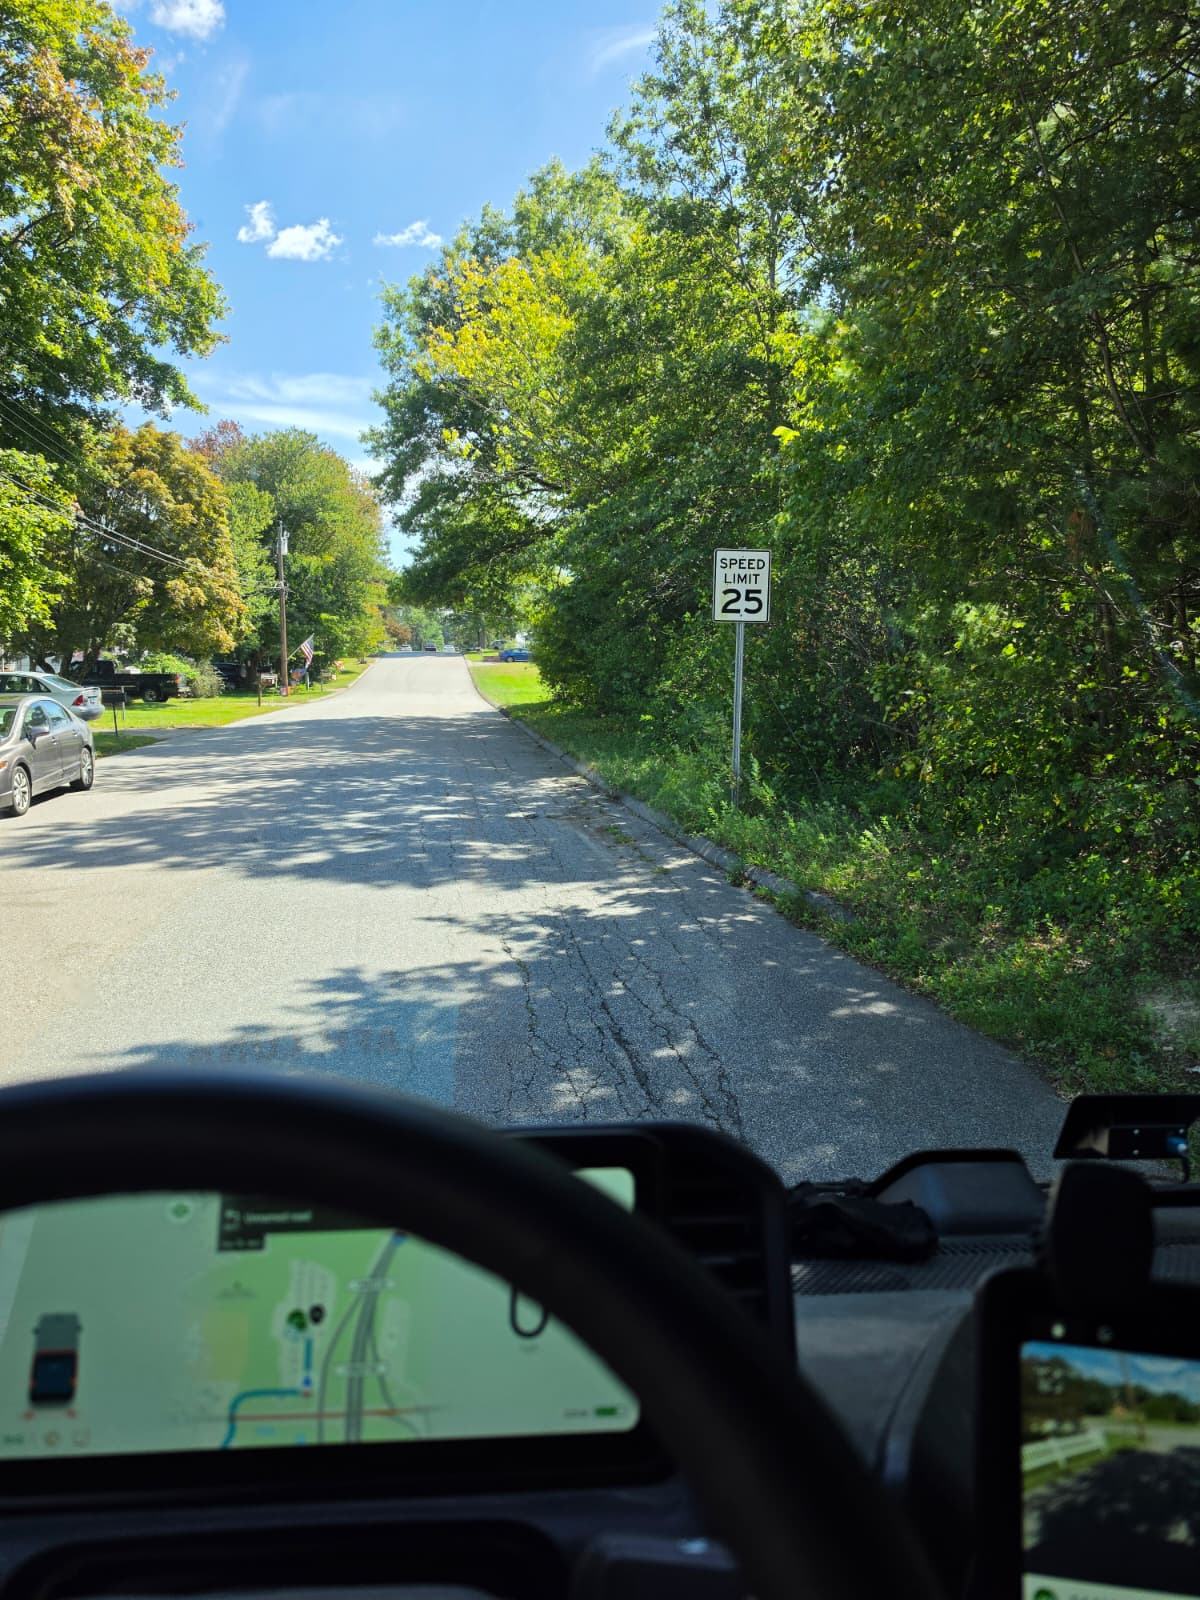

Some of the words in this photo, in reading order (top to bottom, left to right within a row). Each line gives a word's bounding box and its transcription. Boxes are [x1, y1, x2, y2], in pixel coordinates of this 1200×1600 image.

[720, 558, 766, 570] SPEED
[724, 573, 760, 585] LIMIT
[721, 588, 763, 614] 25
